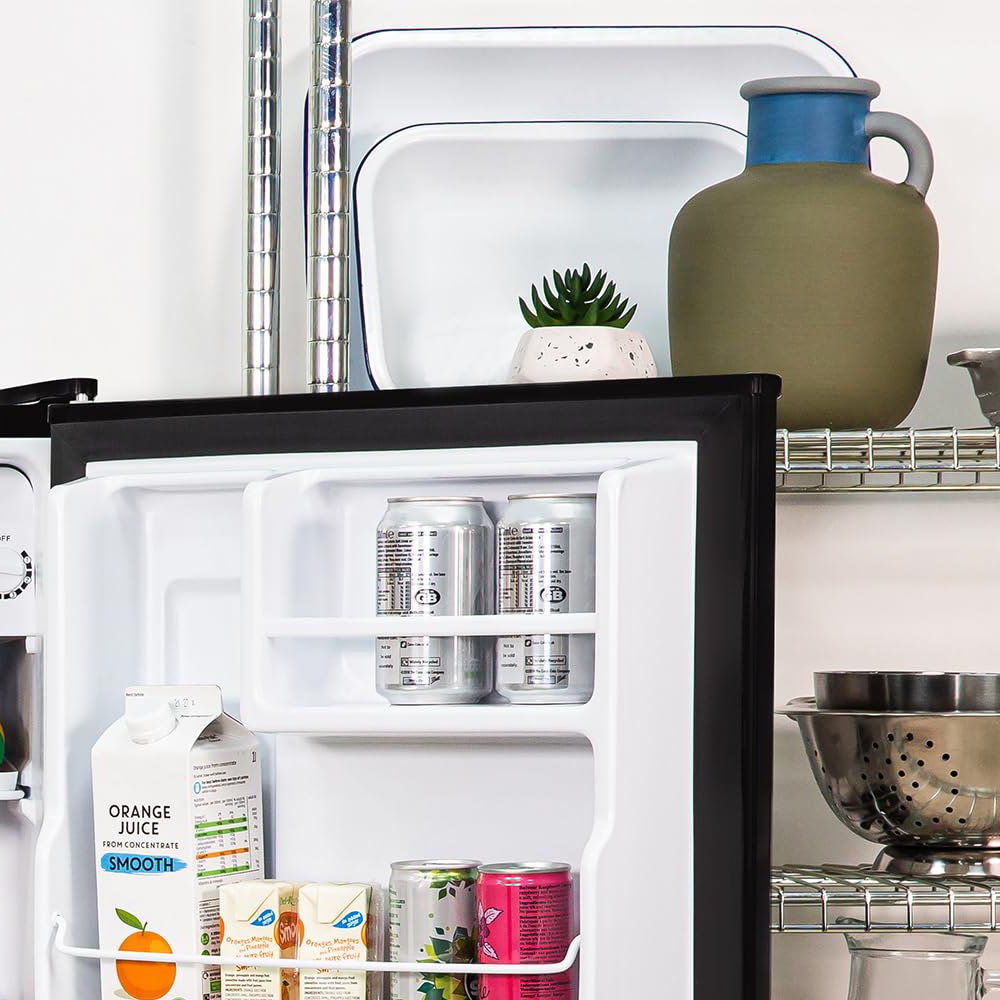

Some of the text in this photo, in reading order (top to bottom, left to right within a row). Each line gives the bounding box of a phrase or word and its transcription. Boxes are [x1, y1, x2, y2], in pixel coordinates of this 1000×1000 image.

[109, 804, 171, 819] ORANGE
[118, 821, 159, 835] JUICE
[109, 856, 174, 872] SMOOTH
